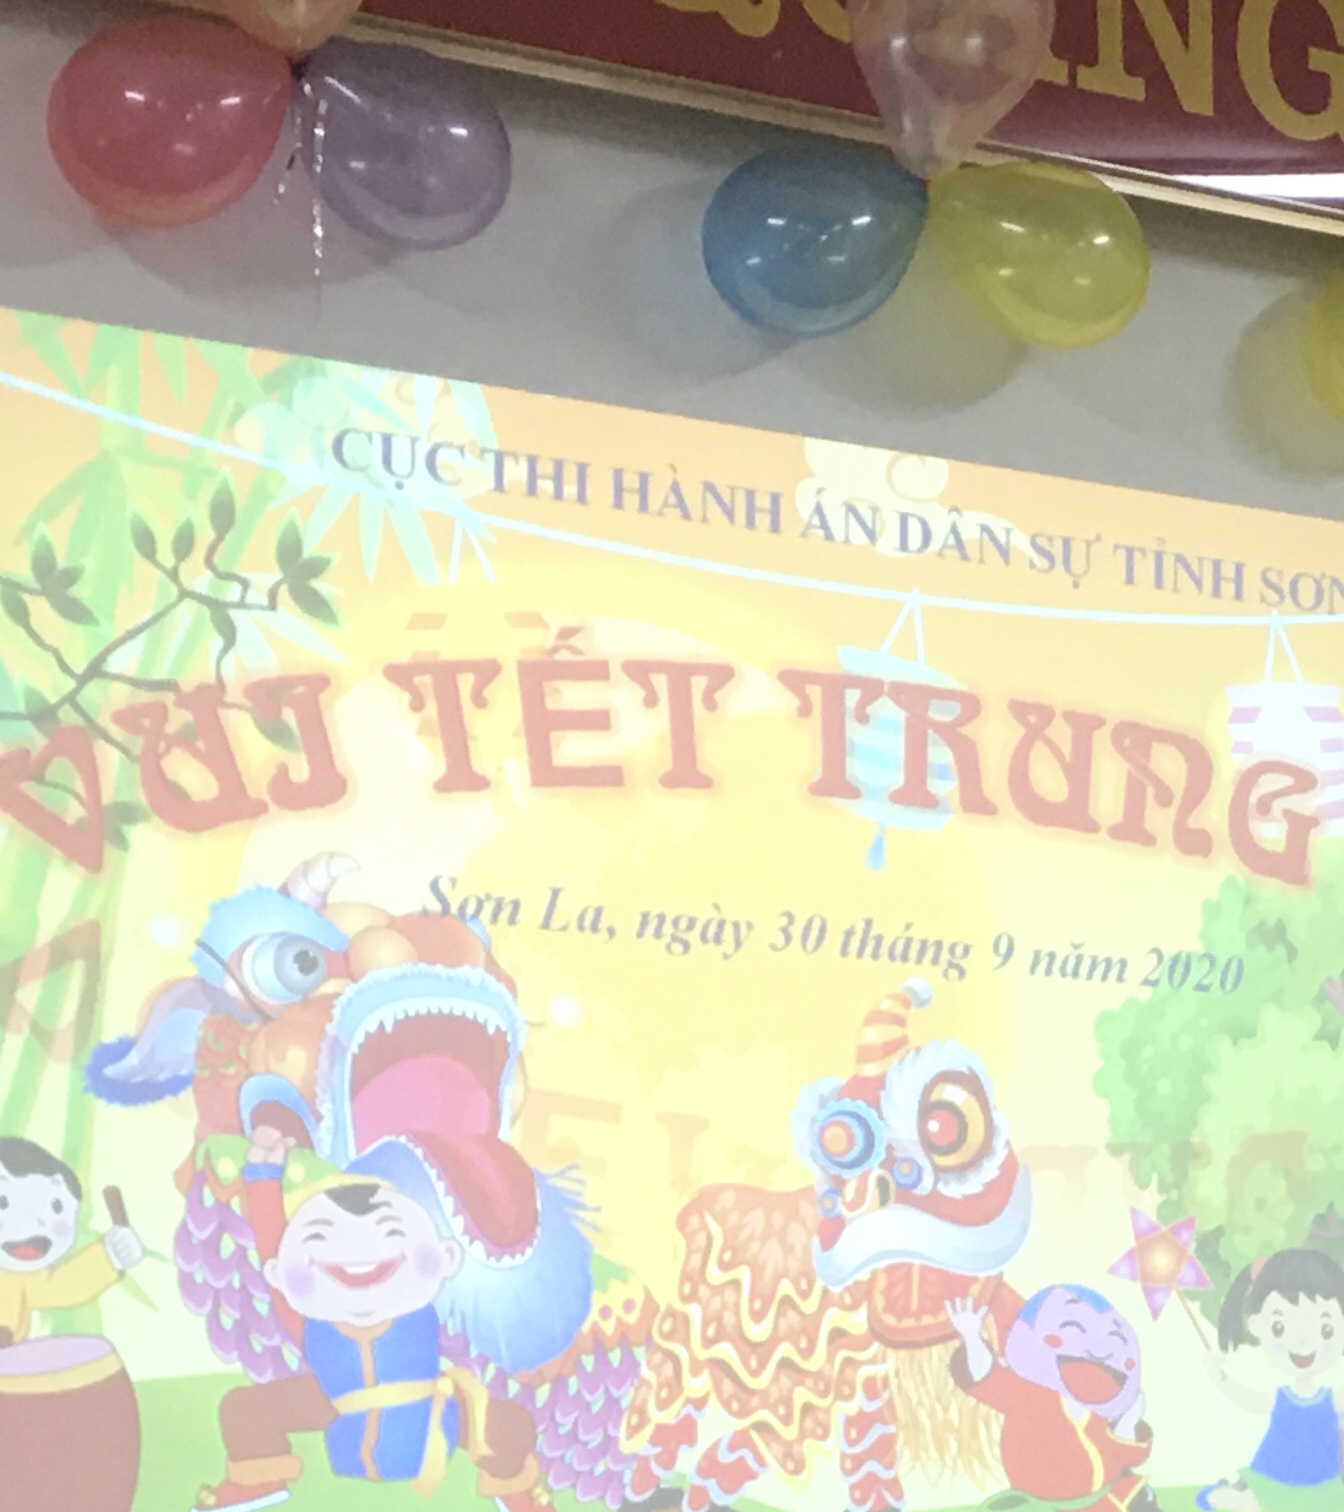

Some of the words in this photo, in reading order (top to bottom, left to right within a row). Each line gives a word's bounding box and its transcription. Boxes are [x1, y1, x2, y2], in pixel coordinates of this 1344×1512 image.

[331, 427, 466, 491] CỤC
[480, 446, 590, 506] THI
[610, 463, 784, 535] HÀNH
[800, 487, 882, 546] ÁN
[895, 505, 1015, 567] DÂN
[1028, 531, 1102, 590] SỰ
[1113, 537, 1246, 602] TỈNH
[382, 626, 735, 794] TẾT
[776, 669, 1321, 886] TRUNG
[421, 874, 522, 928] Sơn
[538, 886, 617, 942] La,
[636, 903, 755, 961] ngày
[768, 910, 829, 957] 30
[838, 916, 974, 983] tháng
[991, 931, 1016, 972] 9
[1029, 940, 1130, 985] năm
[1139, 946, 1246, 996] 2020
